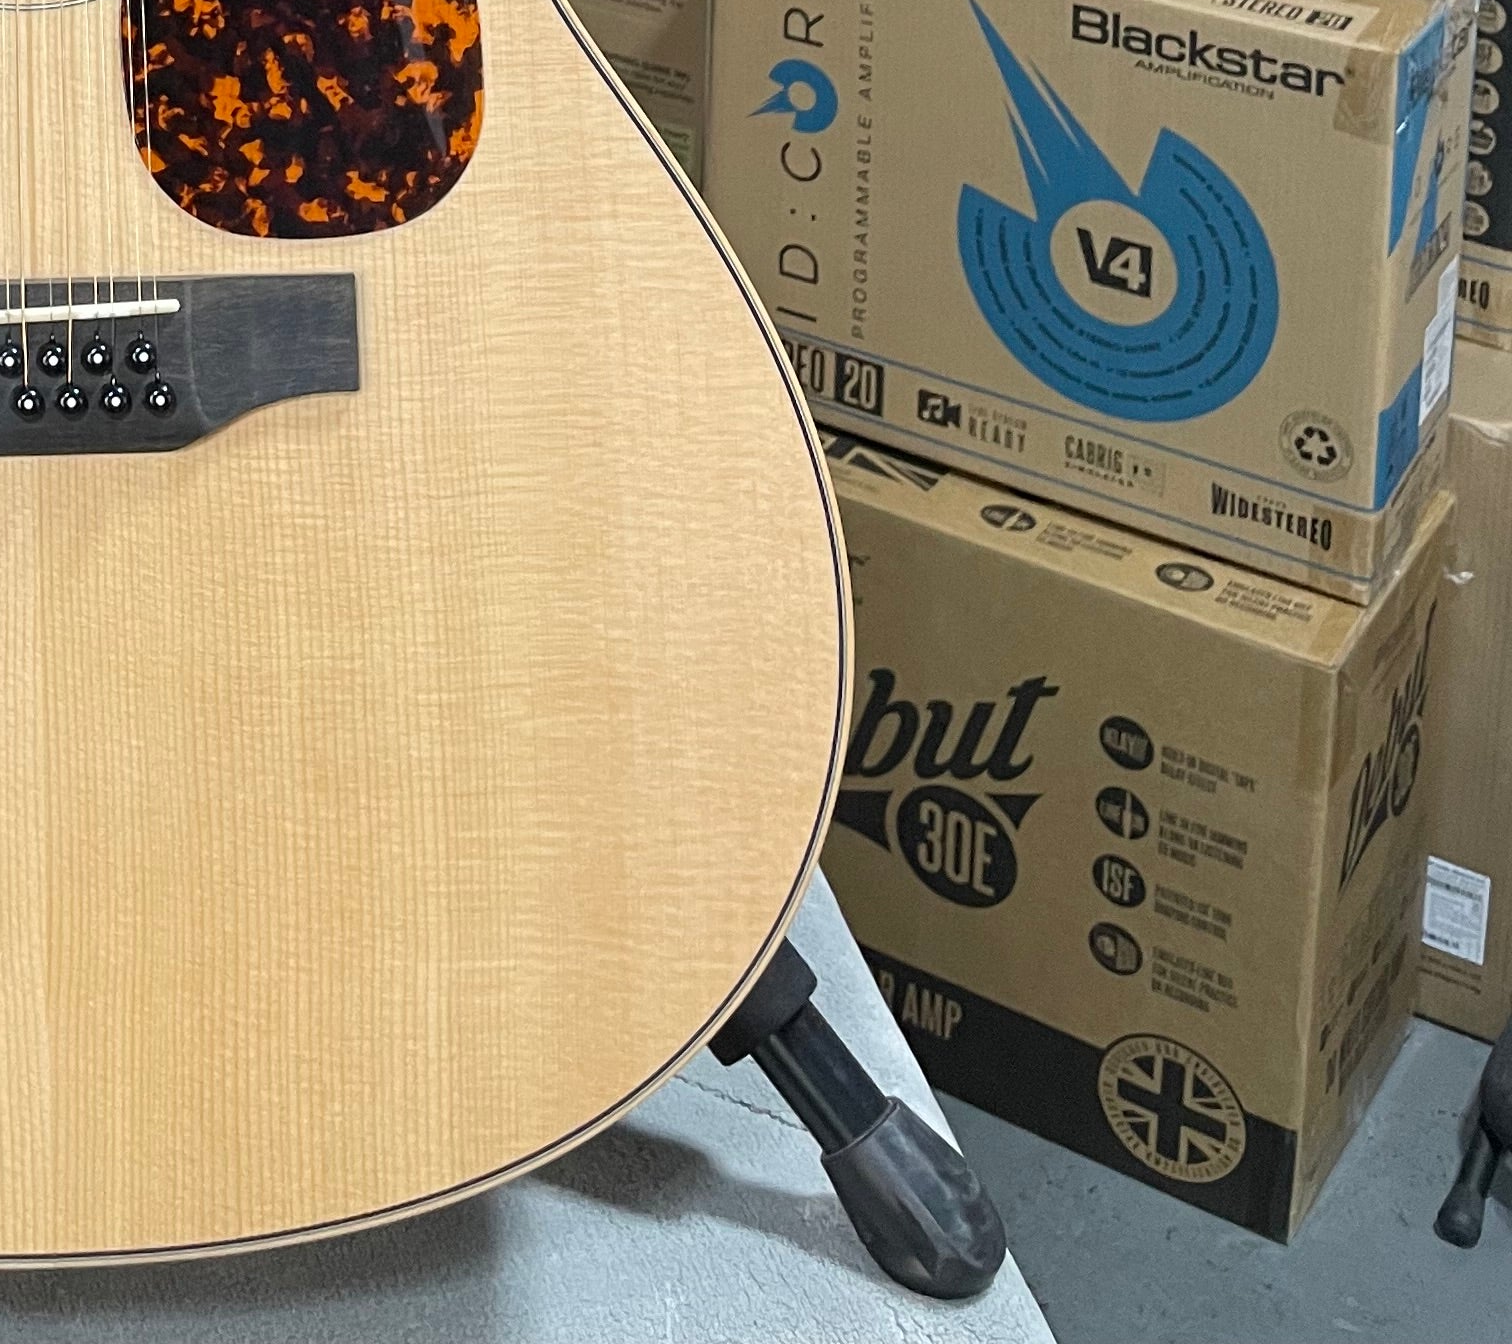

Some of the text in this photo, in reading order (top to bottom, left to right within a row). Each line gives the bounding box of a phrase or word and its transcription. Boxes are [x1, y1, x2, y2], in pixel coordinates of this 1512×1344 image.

[1070, 3, 1346, 98] Blackstar
[851, 114, 873, 341] PROGRAMMABLE
[1076, 227, 1154, 299] V4
[842, 355, 879, 411] 20
[916, 798, 999, 898] 30E
[1101, 859, 1136, 902] ISF
[901, 982, 964, 1041] AMP
